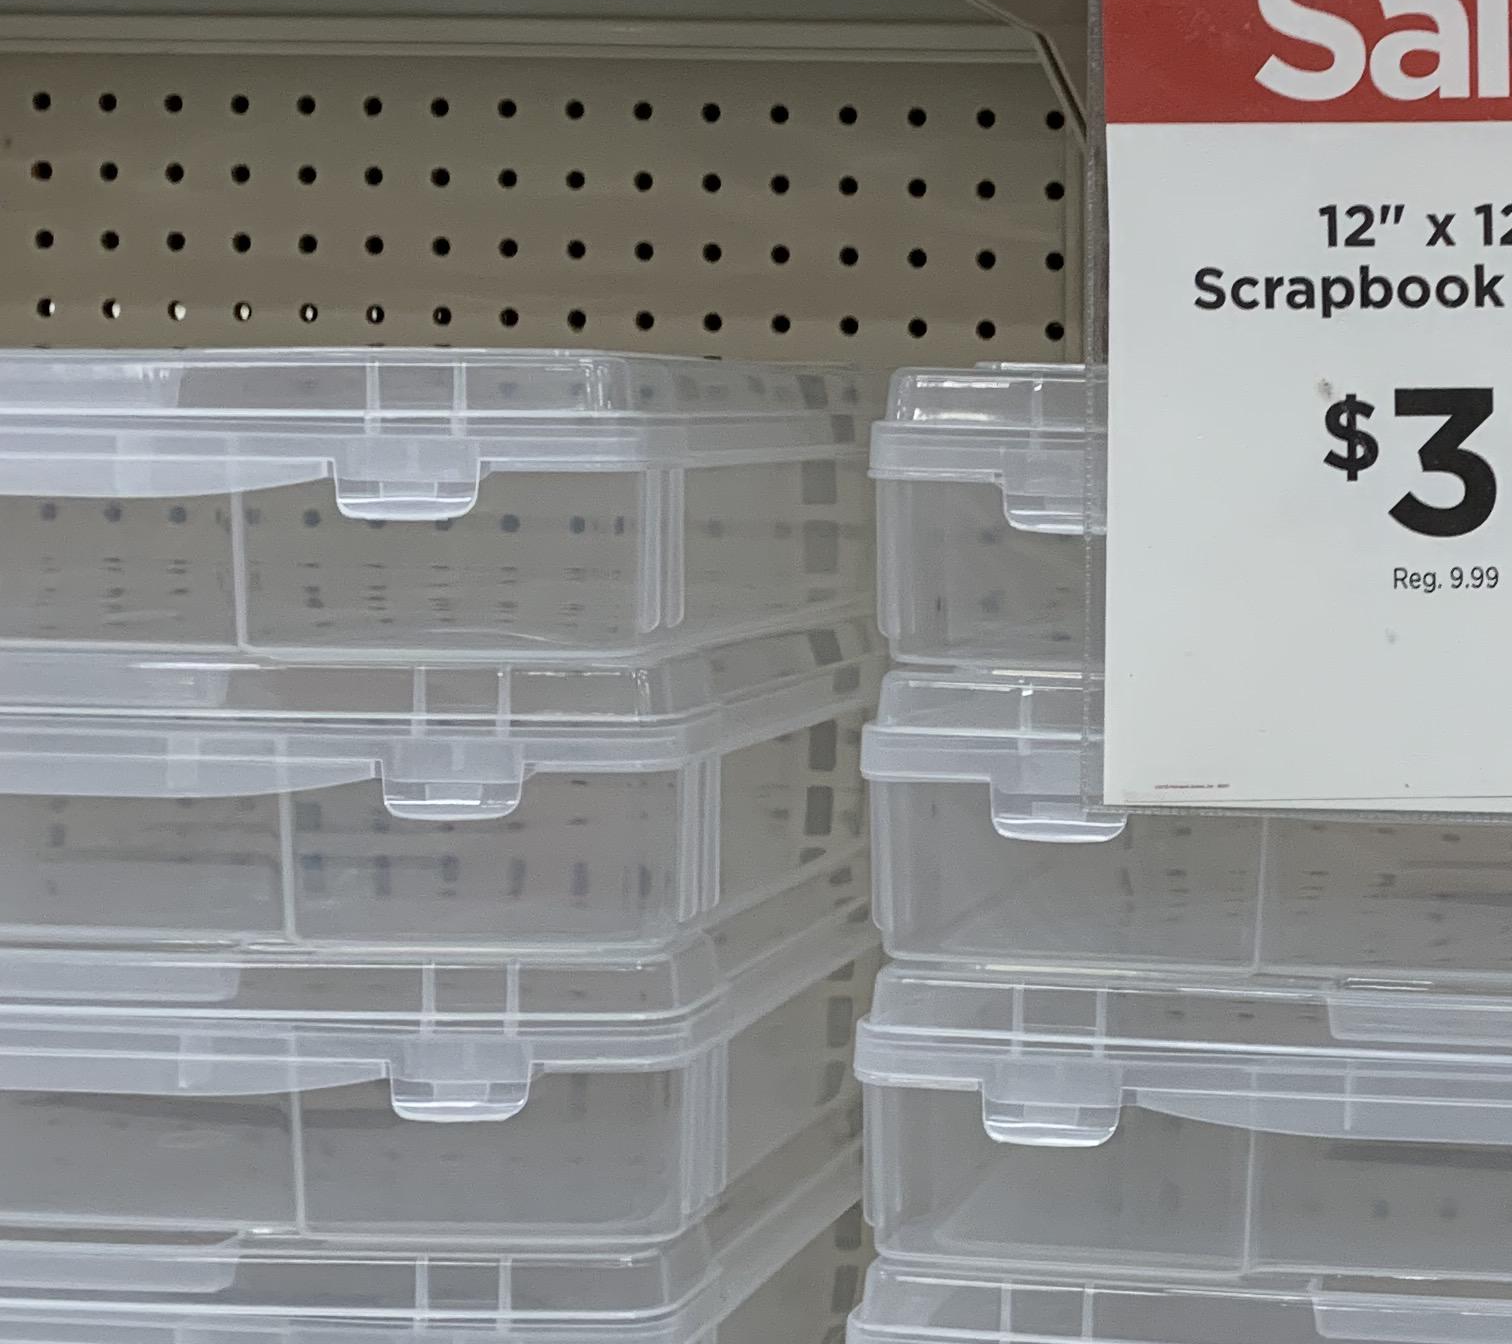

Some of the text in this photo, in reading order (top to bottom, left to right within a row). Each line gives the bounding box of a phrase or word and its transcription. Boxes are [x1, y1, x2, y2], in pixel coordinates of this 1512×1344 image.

[1425, 212, 1457, 247] x
[1193, 265, 1505, 319] Scrapbook
[1393, 566, 1500, 593] Reg. 9.99
